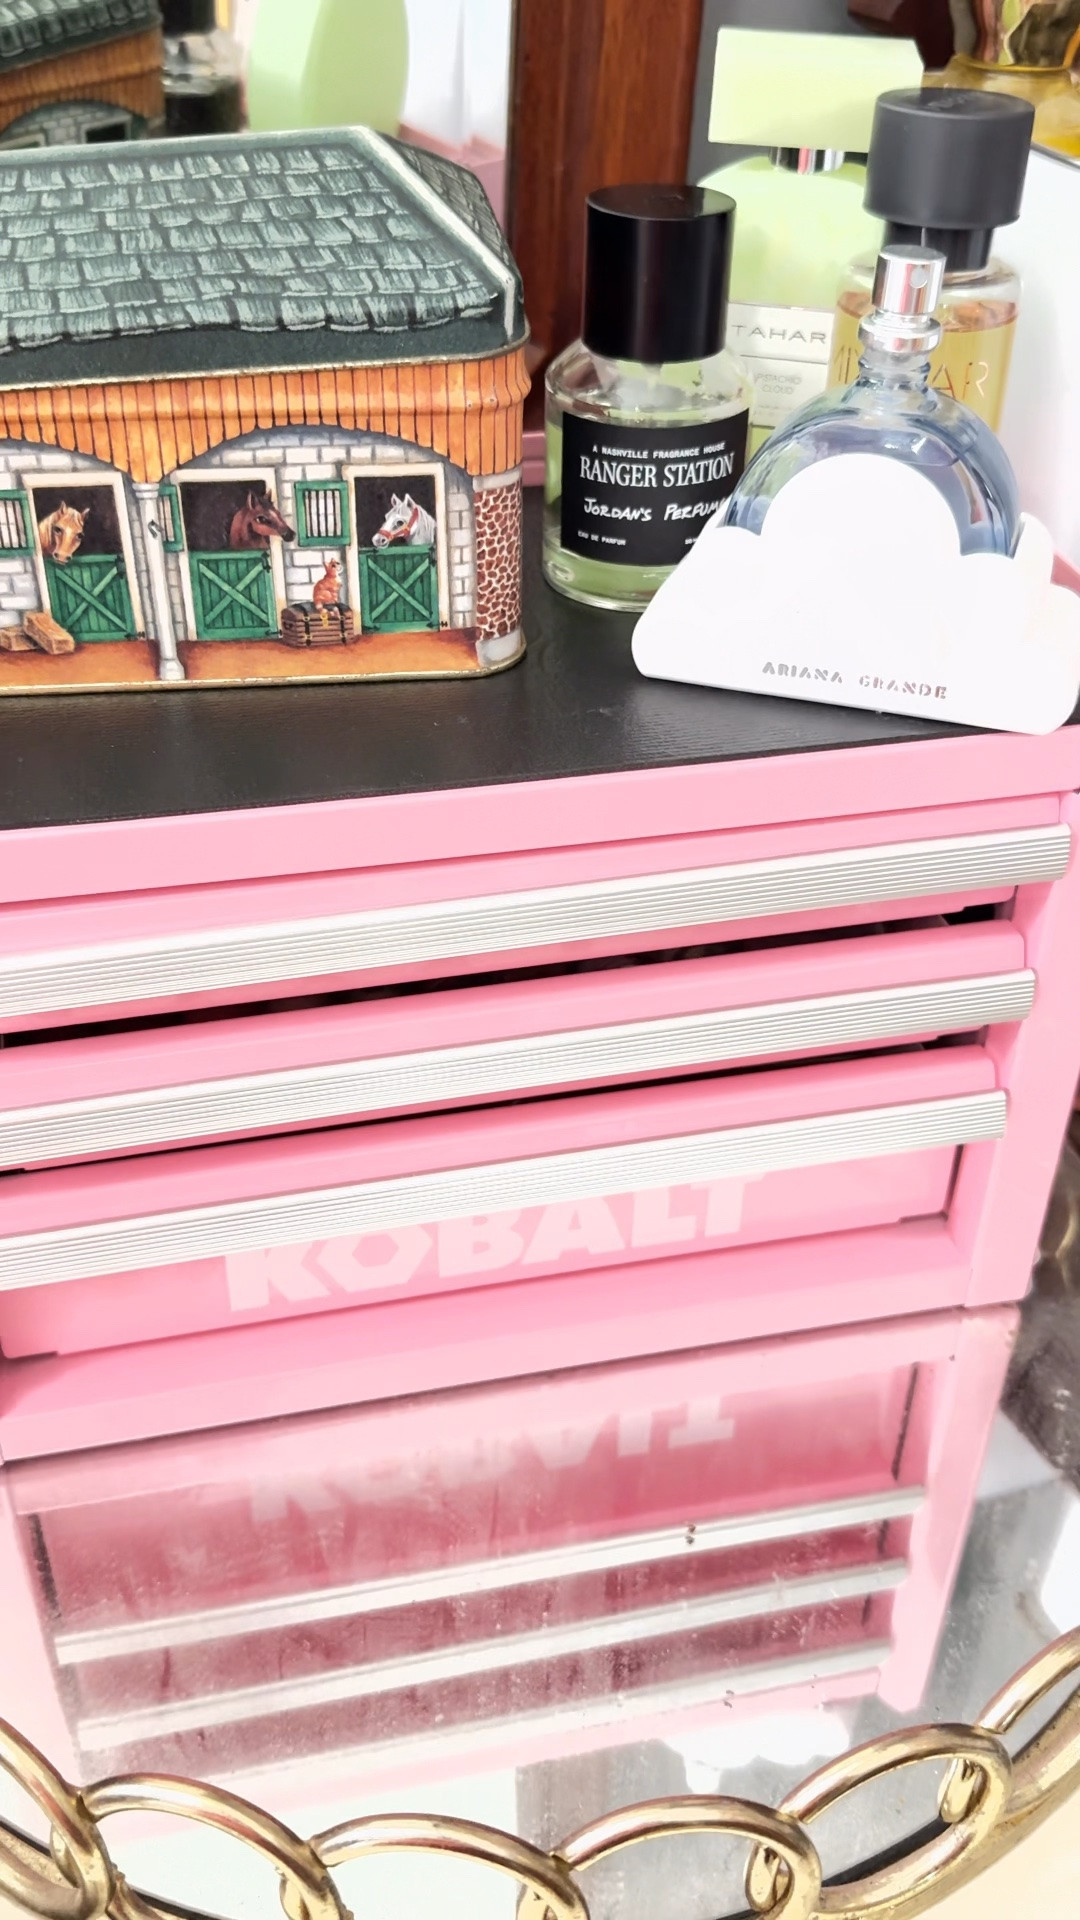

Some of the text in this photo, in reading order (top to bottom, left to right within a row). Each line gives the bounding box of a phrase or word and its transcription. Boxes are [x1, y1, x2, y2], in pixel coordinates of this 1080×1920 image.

[592, 441, 726, 459] A NASHVILLE FRAGRANCE HOUSE
[580, 451, 735, 488] RANGER STATION
[664, 498, 725, 521] PERFUM
[578, 530, 627, 546] EAU DE PARFUM
[762, 661, 948, 700] ARIANA GRANDE
[225, 1172, 768, 1311] KOBALT
